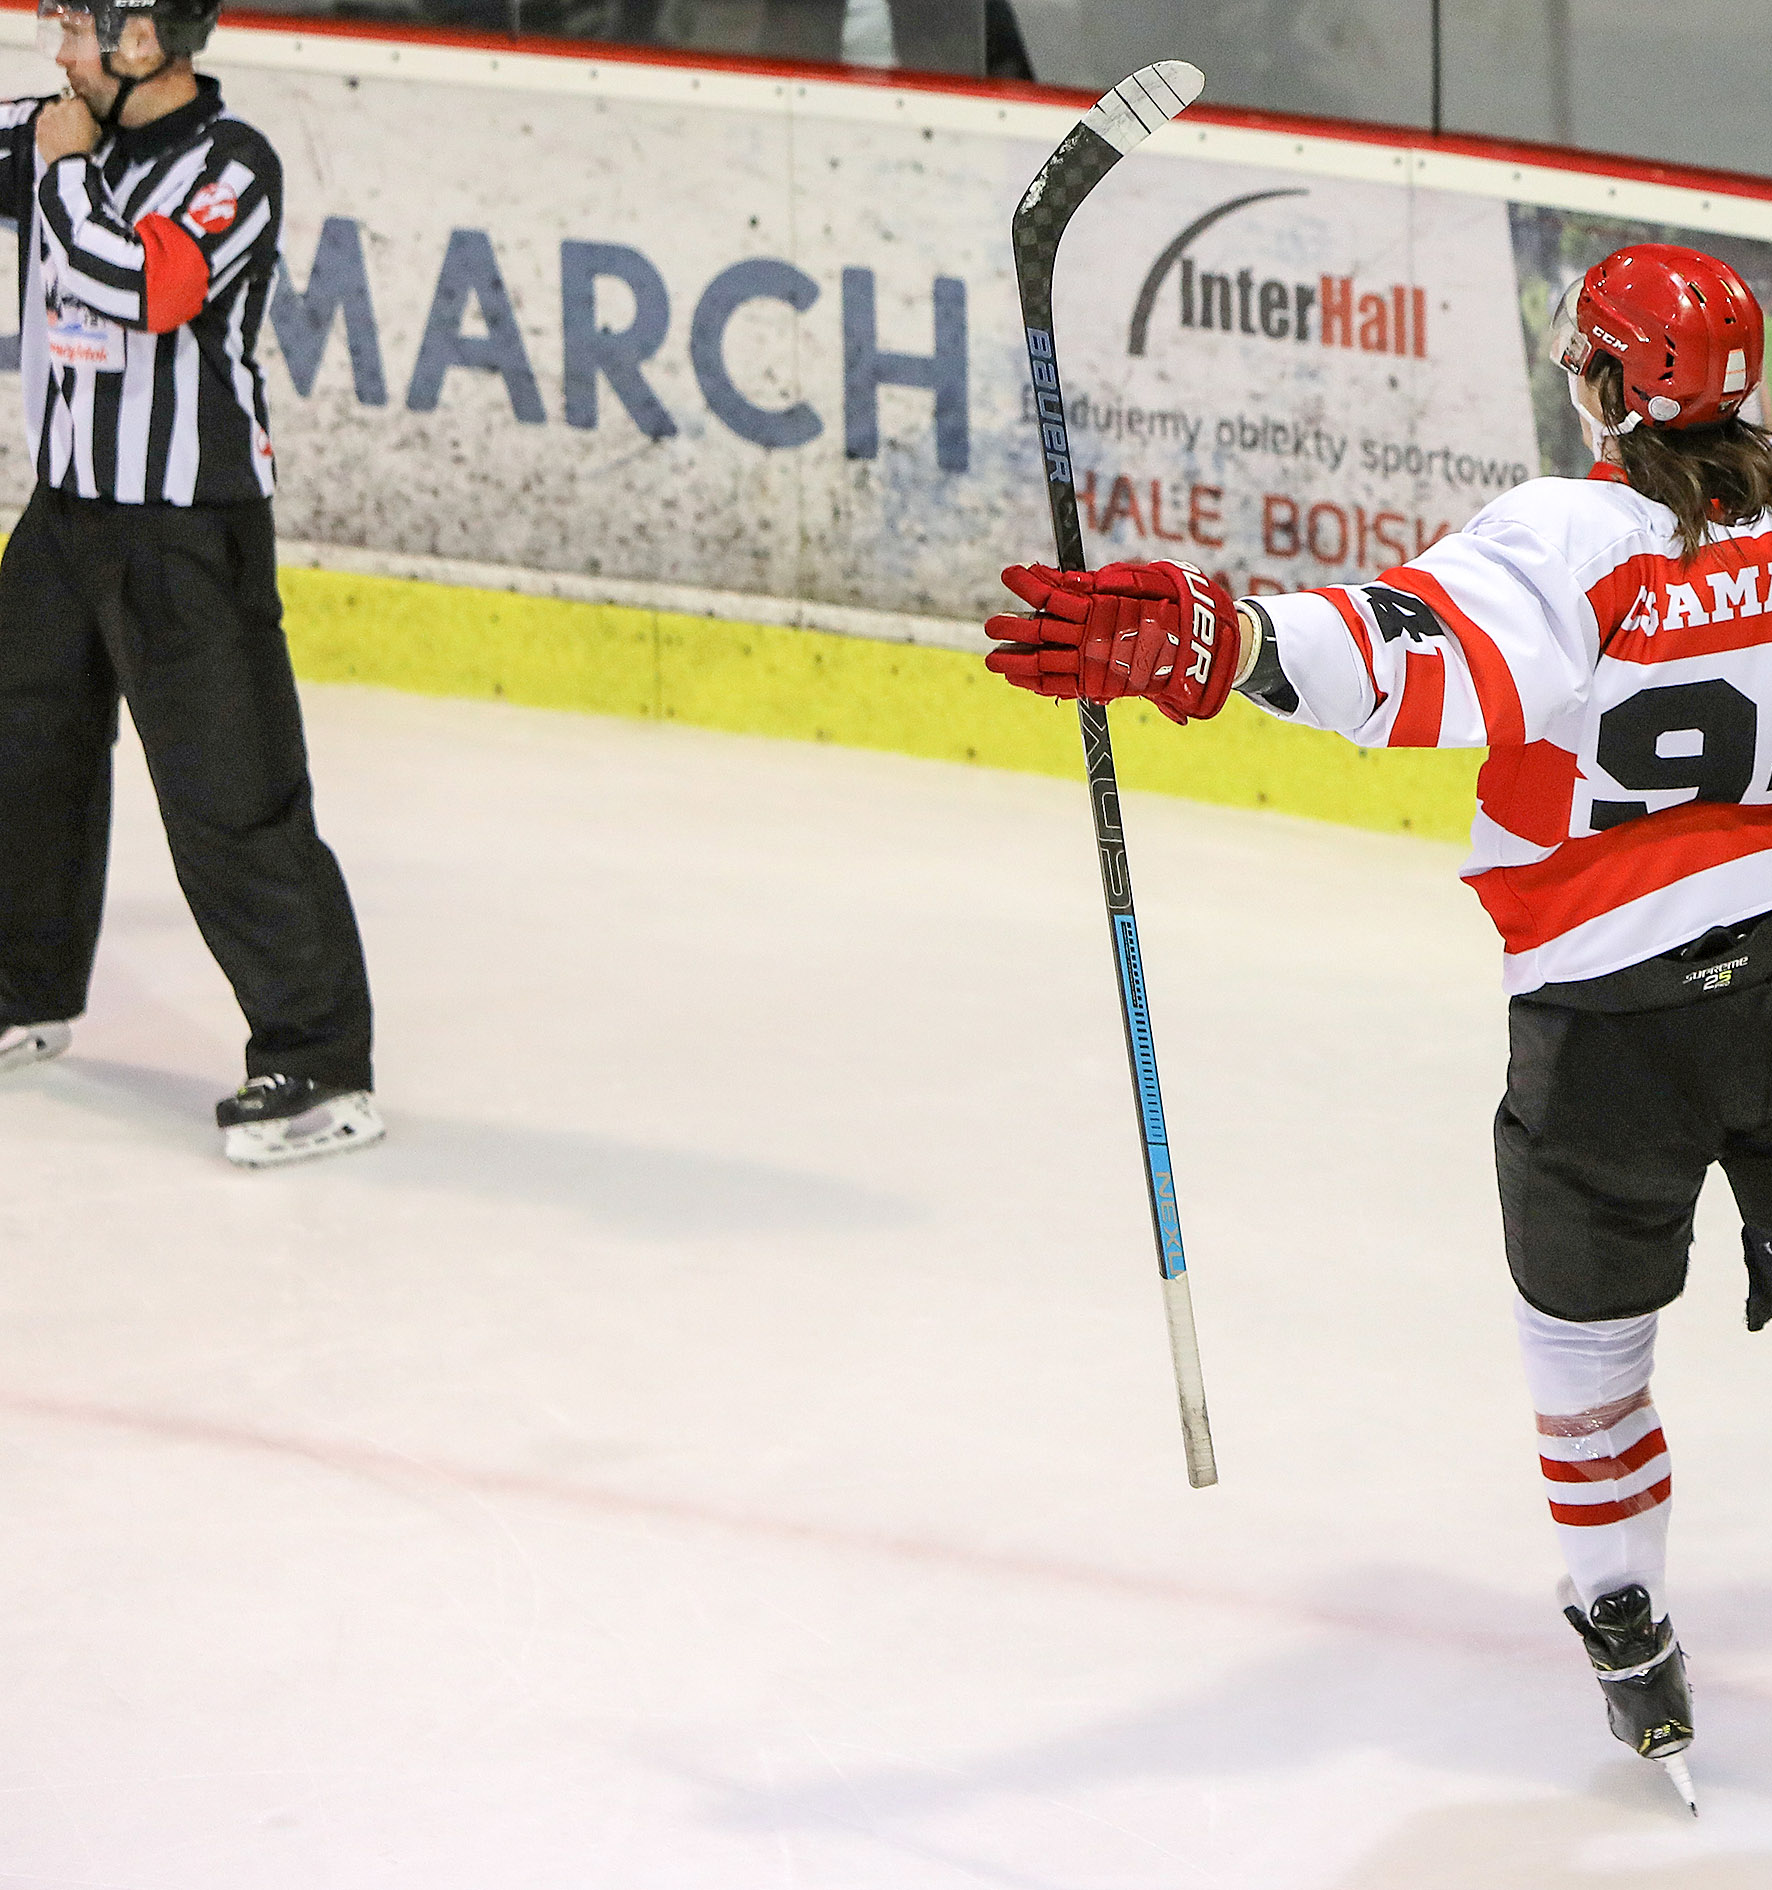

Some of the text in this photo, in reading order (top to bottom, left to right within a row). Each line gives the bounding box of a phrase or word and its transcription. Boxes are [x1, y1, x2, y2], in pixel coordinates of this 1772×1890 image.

[268, 217, 969, 473] MARCH
[1181, 257, 1428, 359] InterHall
[1592, 325, 1630, 352] CCM
[1360, 436, 1529, 487] sportowe
